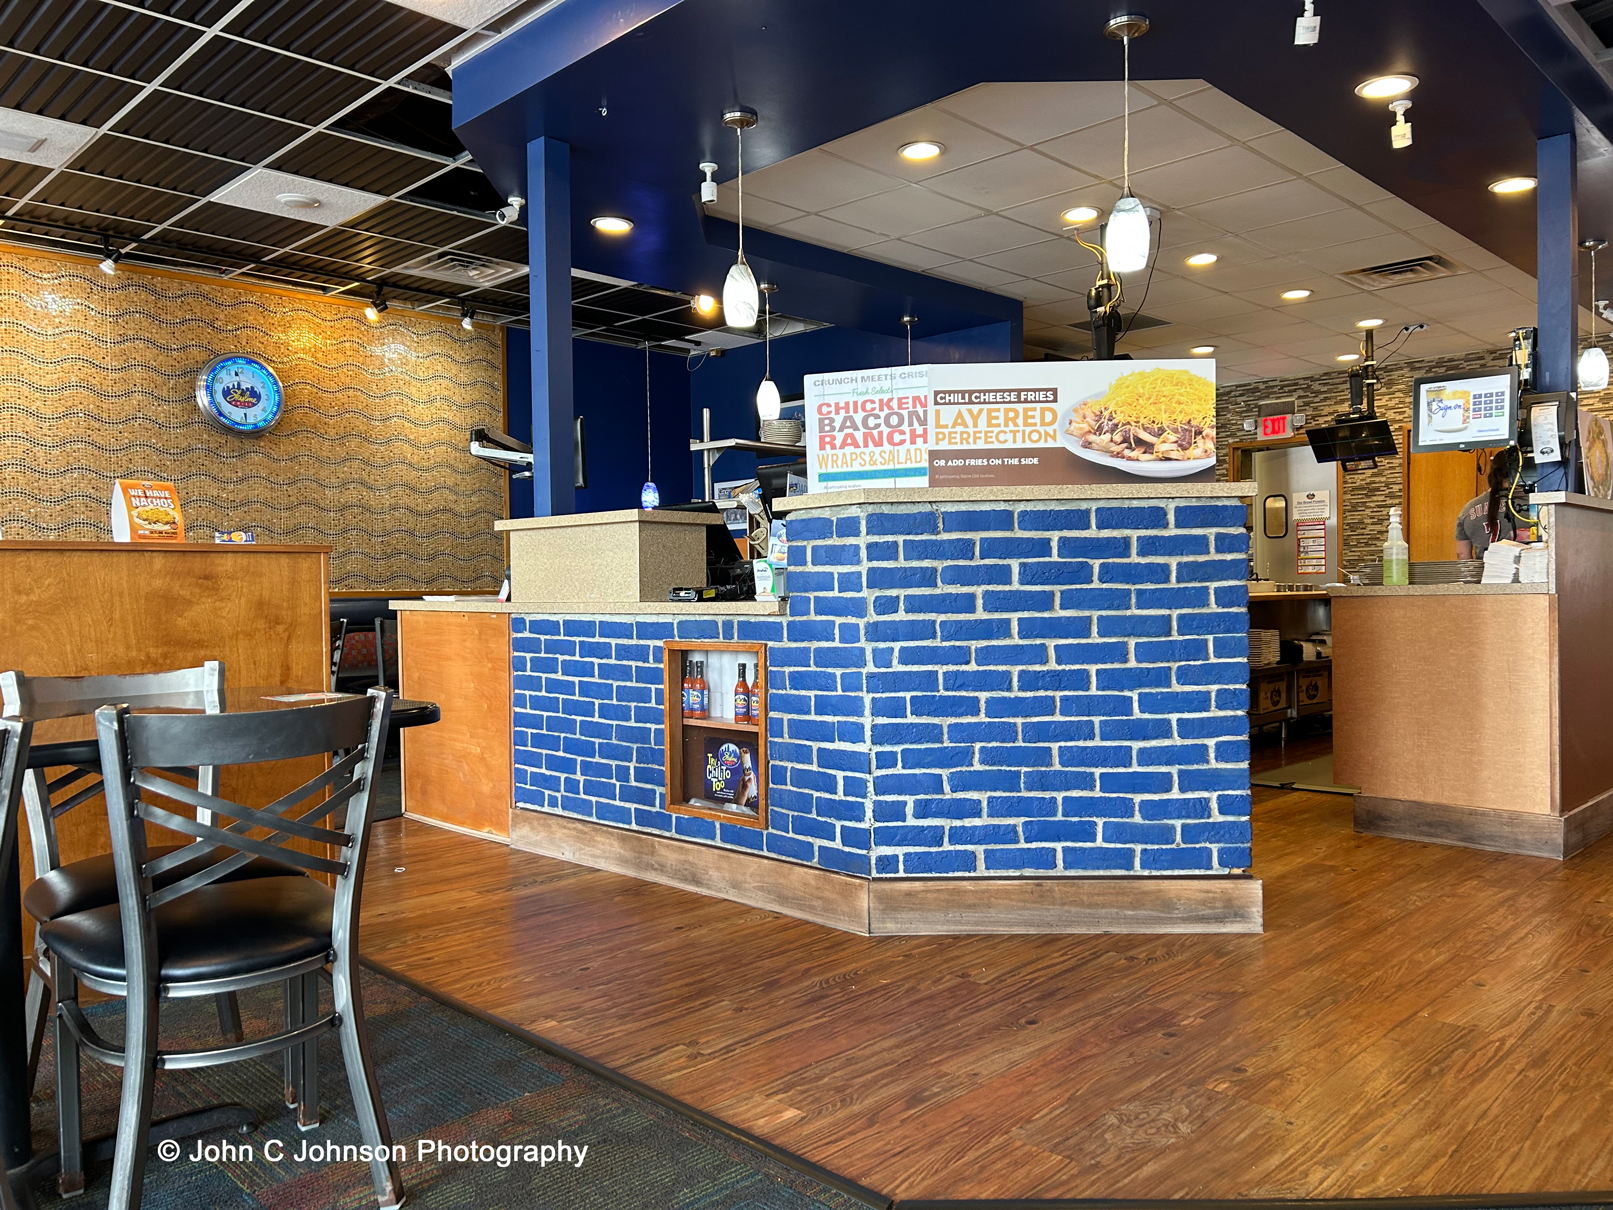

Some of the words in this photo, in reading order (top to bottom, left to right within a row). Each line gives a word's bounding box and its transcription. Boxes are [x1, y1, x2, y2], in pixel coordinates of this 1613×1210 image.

[813, 377, 858, 387] CRUNCH
[860, 373, 897, 383] MEETS
[899, 370, 928, 380] CRIS
[227, 389, 258, 403] Skyline
[851, 388, 870, 397] Fresh
[871, 386, 894, 395] Selects
[937, 393, 969, 403] CHILI
[971, 391, 1018, 402] CHEESE
[1020, 391, 1054, 401] FRIES
[816, 395, 928, 416] CHICKEN
[1432, 400, 1453, 418] Sign
[818, 409, 928, 434] BACON
[934, 406, 1058, 430] LAYERED
[1262, 415, 1288, 437] EXIT
[818, 427, 928, 451] RANCH
[934, 429, 1057, 446] PERFECTION
[933, 459, 946, 467] OR
[947, 458, 965, 467] ADD
[965, 458, 988, 466] FRIES
[989, 458, 1002, 466] ON
[1003, 457, 1020, 465] THE
[1020, 457, 1039, 465] SIDE
[128, 488, 146, 497] WE
[146, 489, 171, 498] HAVE
[131, 497, 175, 509] NACHOS
[711, 778, 725, 791] Too
